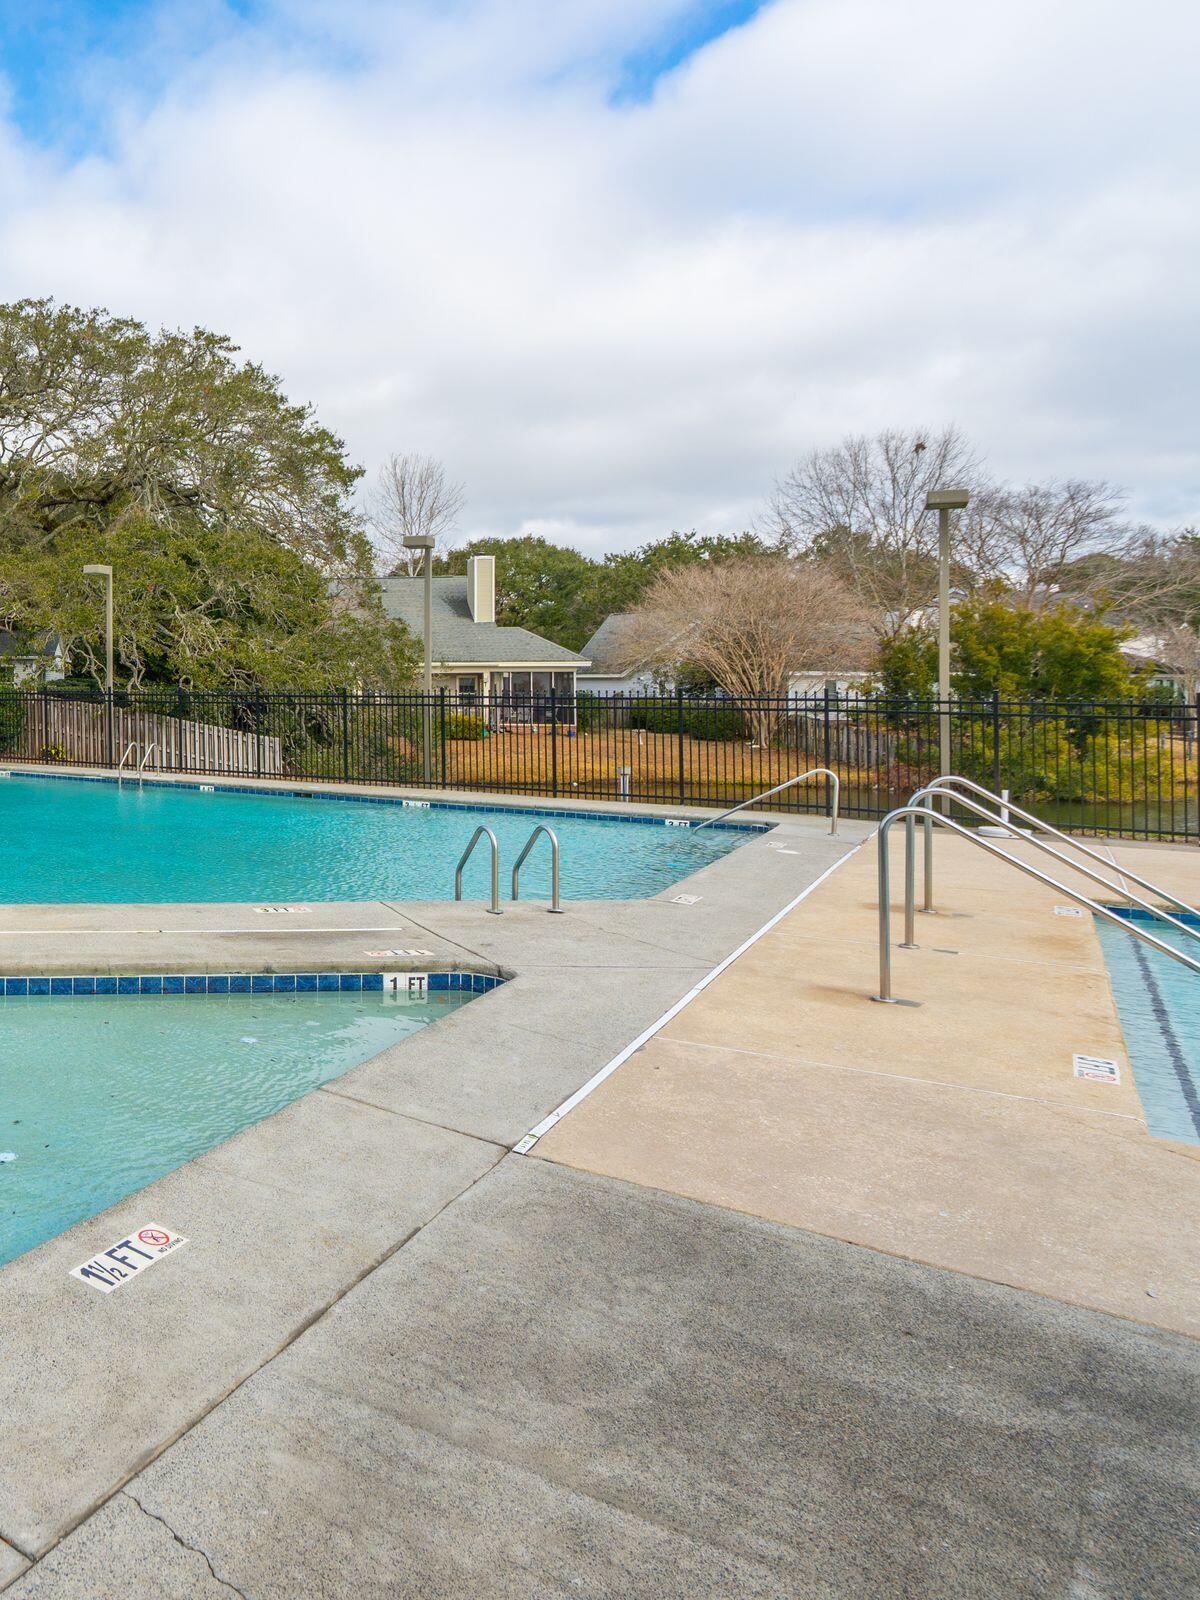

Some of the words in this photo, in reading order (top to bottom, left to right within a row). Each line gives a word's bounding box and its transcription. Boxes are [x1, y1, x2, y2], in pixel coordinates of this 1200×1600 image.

[389, 977, 397, 990] 1
[408, 977, 425, 990] FT
[104, 1239, 154, 1270] FT
